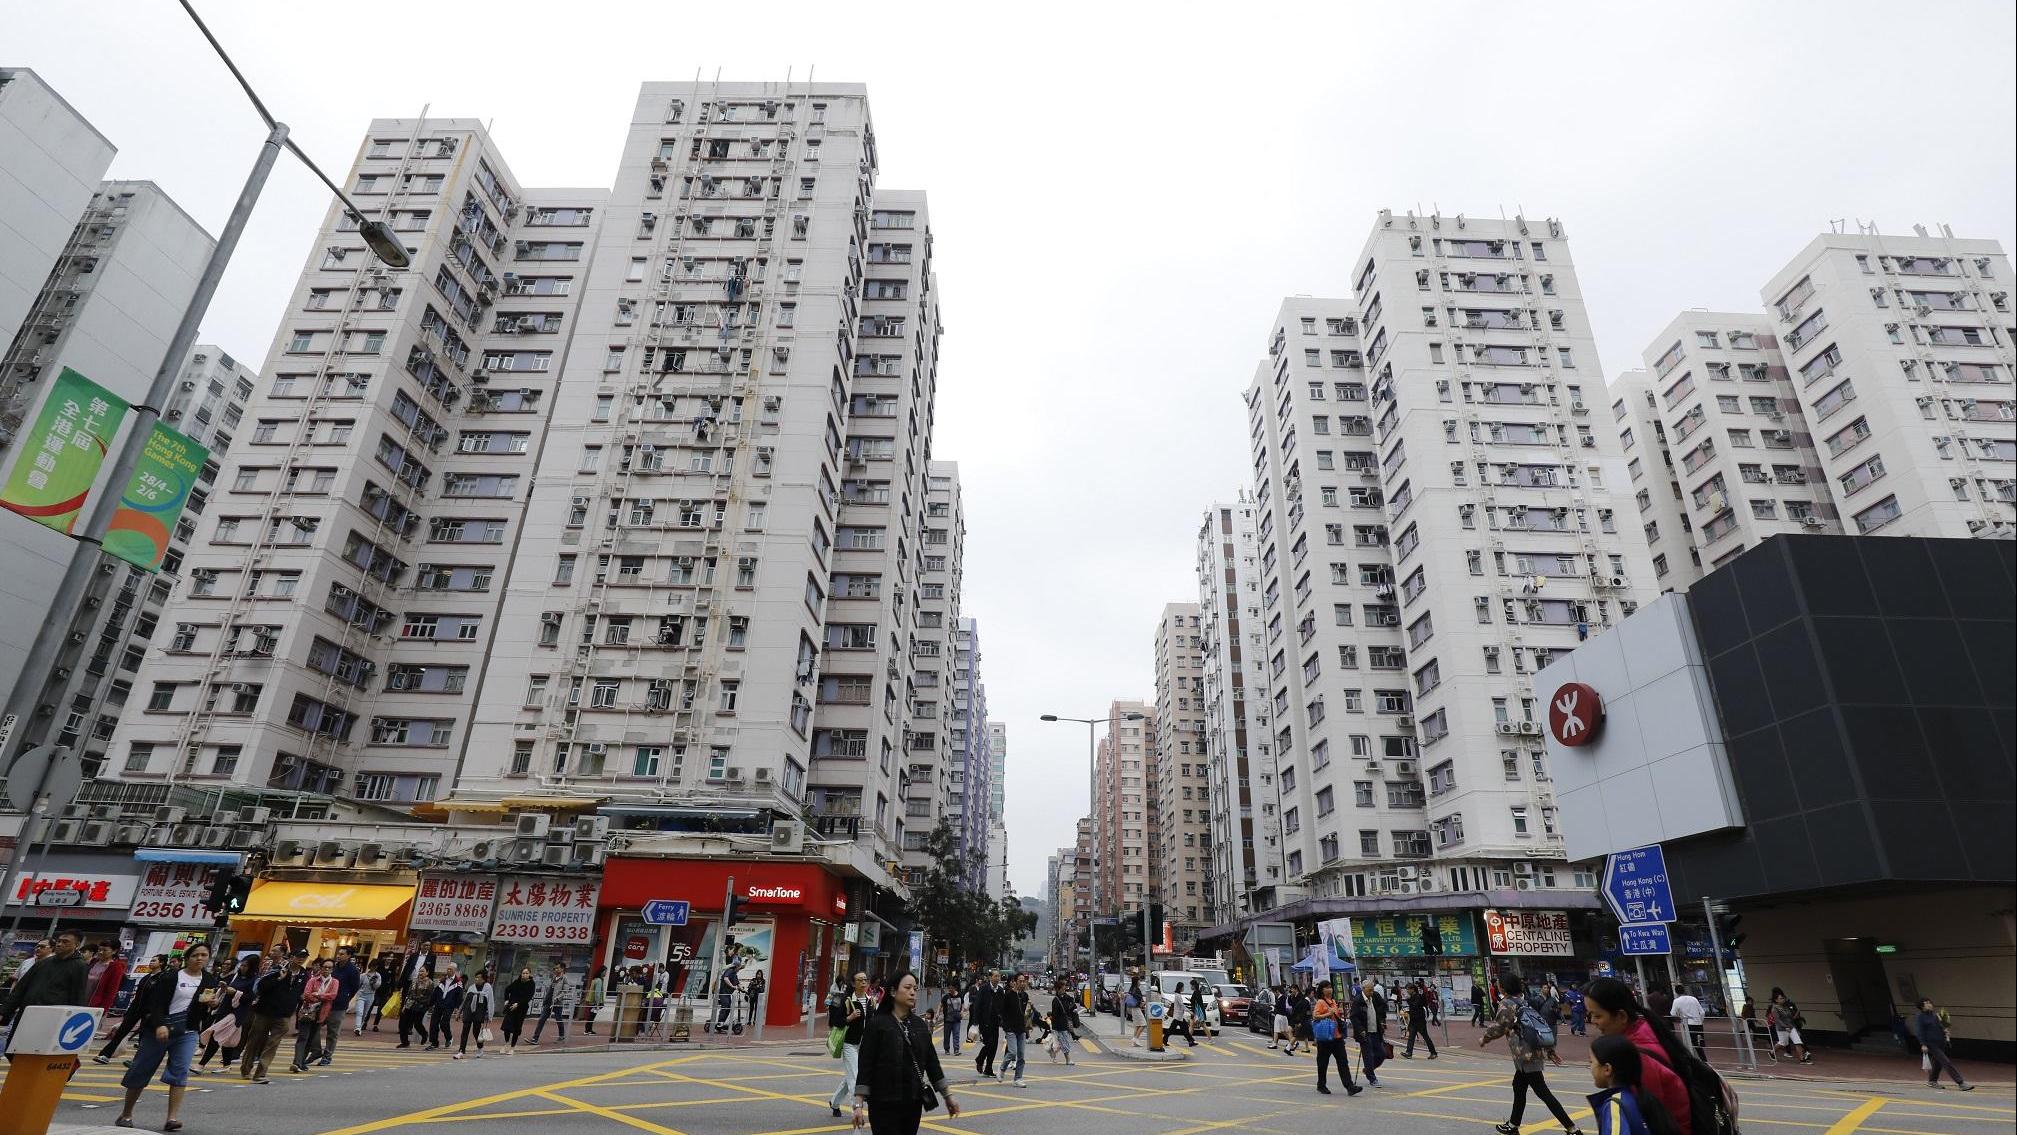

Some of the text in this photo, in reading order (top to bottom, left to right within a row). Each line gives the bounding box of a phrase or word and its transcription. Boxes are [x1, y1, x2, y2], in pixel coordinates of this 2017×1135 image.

[70, 396, 109, 451] 第七屆
[27, 399, 81, 491] 全港運動會
[153, 429, 187, 454] The 7th
[144, 447, 175, 471] Games
[148, 439, 198, 473] Hong Kong
[136, 485, 157, 501] 2/6
[1617, 851, 1646, 862] Hung Hom
[1620, 862, 1636, 873] 紅磡
[1622, 874, 1665, 887] Hong Kong (C)
[140, 888, 163, 897] FORTUNE
[165, 889, 176, 897] REAL
[178, 889, 197, 898] ESTATE
[420, 878, 496, 900] 麗的地產
[502, 880, 596, 909] 太陽物業
[748, 886, 801, 898] SmarTone
[1624, 887, 1656, 900] 香港(中)
[133, 901, 185, 918] 2356
[417, 901, 488, 918] 2365 8868
[658, 903, 674, 912] Ferry
[498, 910, 592, 923] SUNRISE PROPERTY
[656, 912, 676, 921] 渡輪
[1504, 913, 1569, 930] 中原地產
[495, 923, 589, 940] 2330 9338
[1507, 930, 1571, 942] CENTALINE
[1508, 942, 1568, 953] PROPERTY
[1632, 939, 1657, 950] 土瓜灣
